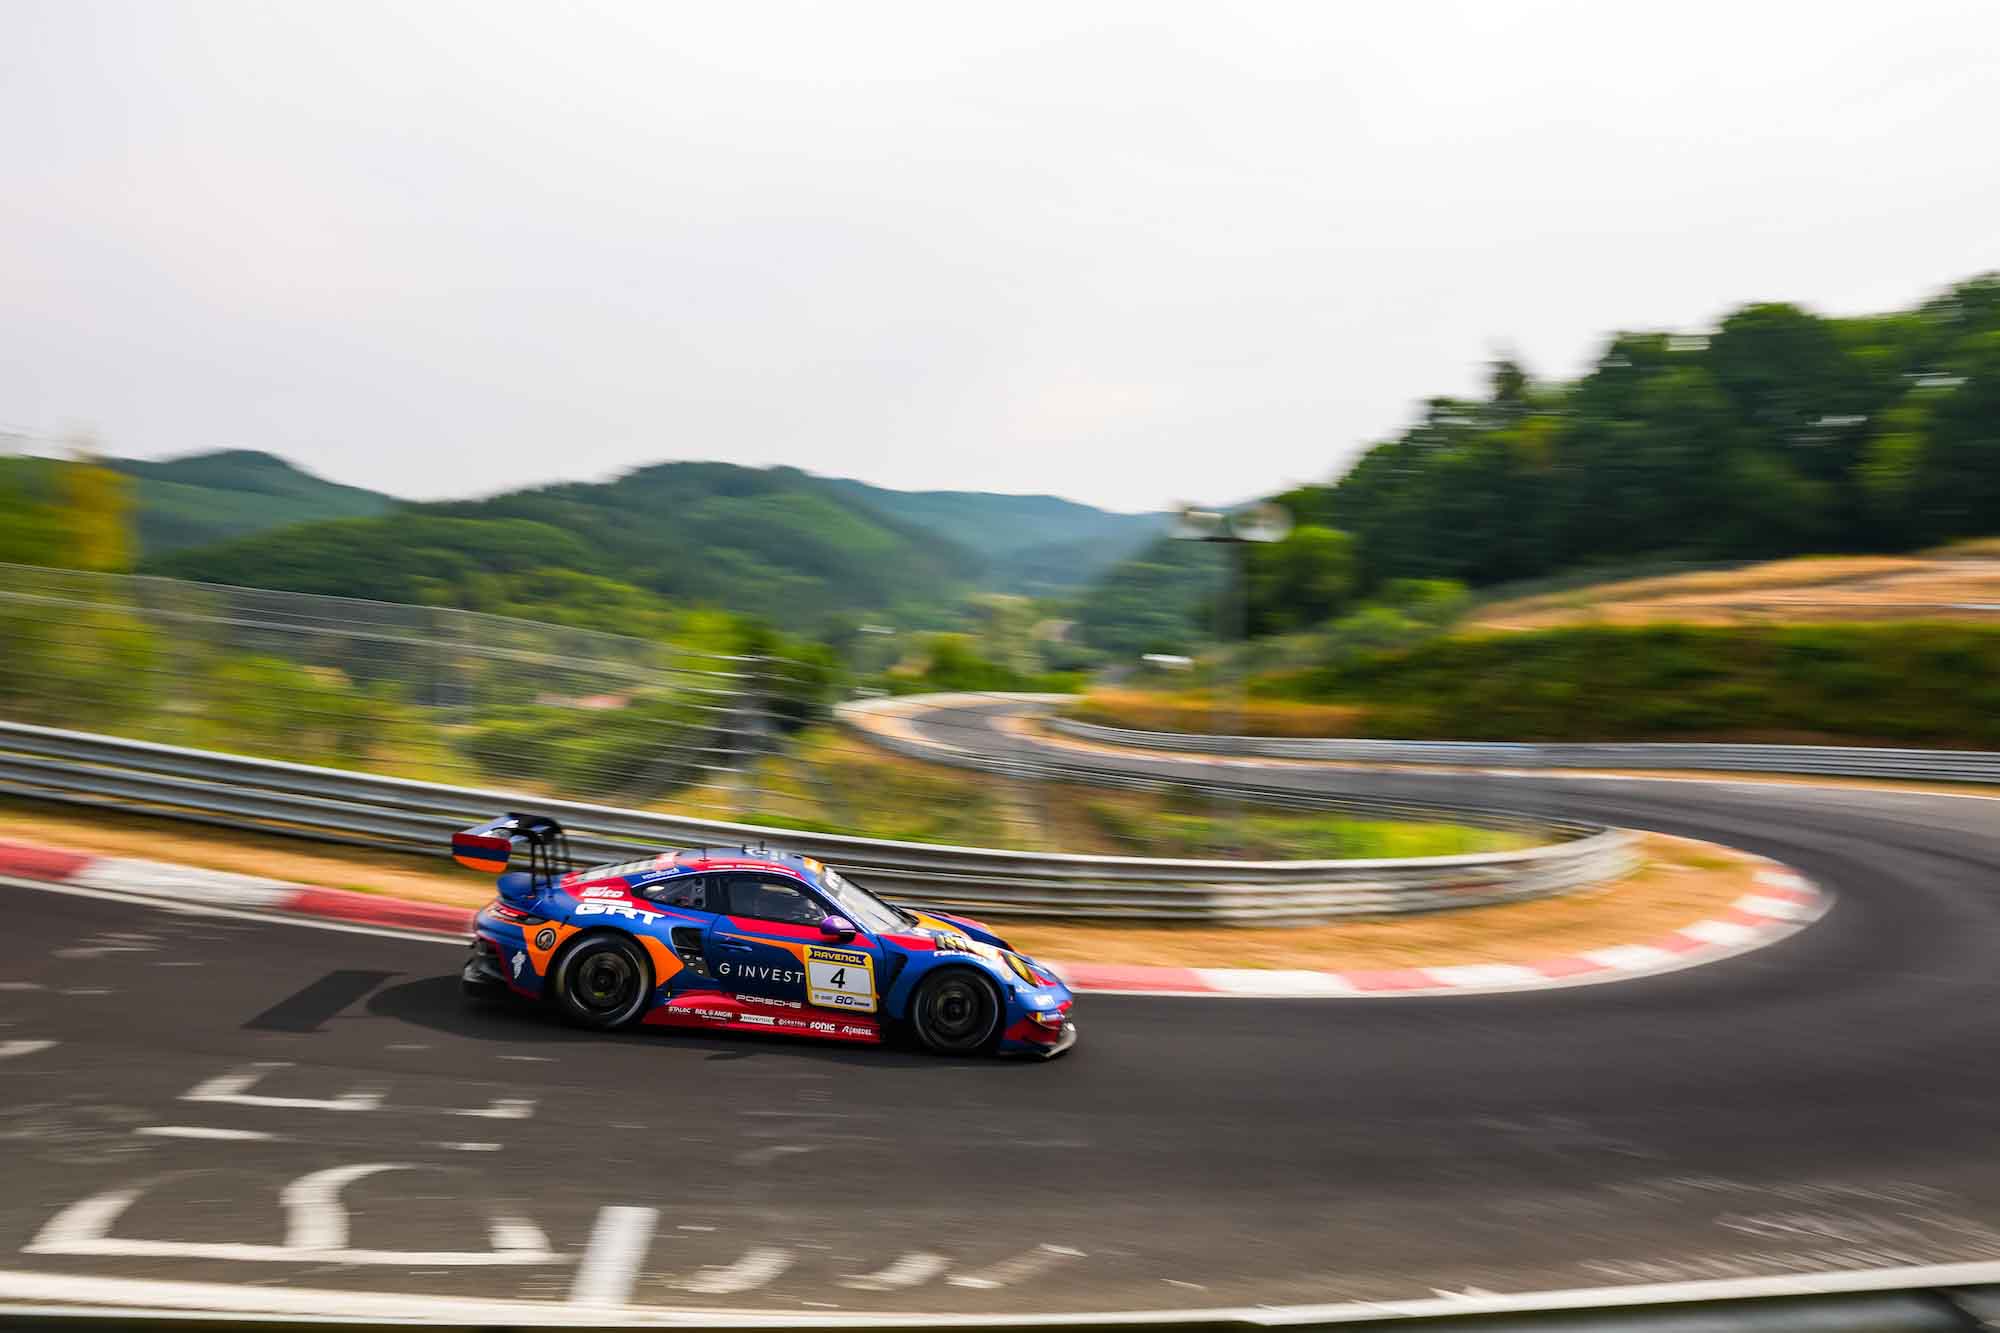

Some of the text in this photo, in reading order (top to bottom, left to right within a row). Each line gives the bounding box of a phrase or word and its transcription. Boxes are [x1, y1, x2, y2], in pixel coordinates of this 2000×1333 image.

[813, 950, 862, 964] RAVENOL
[719, 963, 805, 984] G INVEST
[830, 968, 846, 989] 4
[736, 994, 802, 1009] PORSCHE
